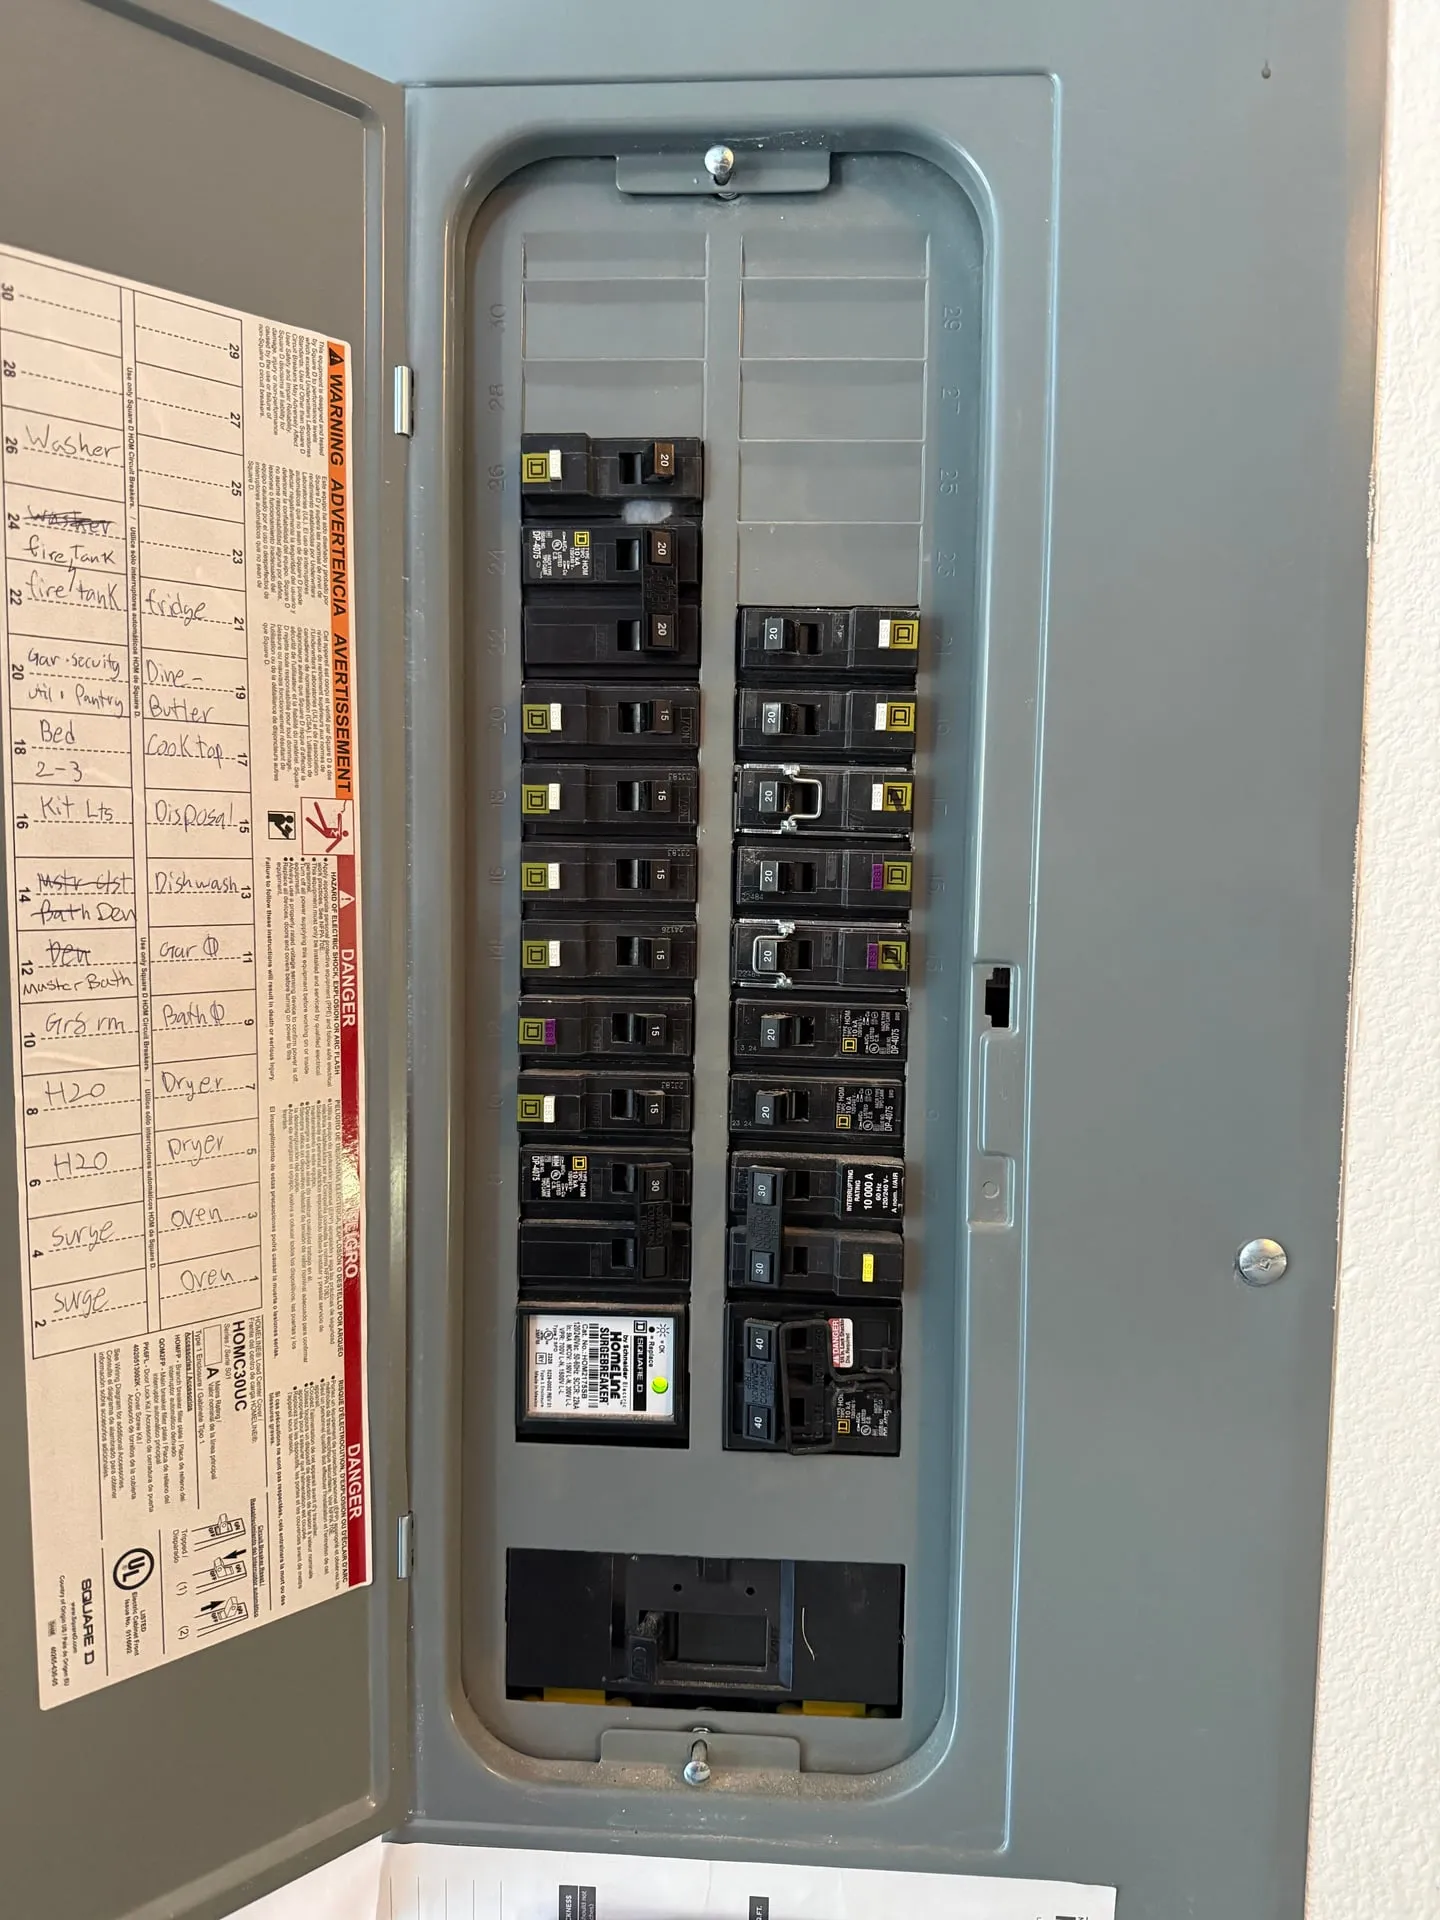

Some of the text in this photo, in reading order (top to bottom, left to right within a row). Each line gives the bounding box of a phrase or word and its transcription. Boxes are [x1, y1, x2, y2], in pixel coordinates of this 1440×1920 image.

[1, 283, 14, 301] 30
[229, 343, 240, 359] 29
[3, 360, 16, 378] 28
[230, 412, 241, 429] 27
[330, 374, 344, 466] WARNING
[6, 436, 18, 454] 26
[26, 424, 121, 458] Washer
[660, 454, 669, 468] 20
[231, 480, 242, 497] 25
[8, 514, 20, 530] 24
[23, 535, 67, 563] fire
[331, 479, 347, 617] ADVERTENCIA
[532, 530, 541, 560] DP-4075
[657, 541, 666, 556] 20
[232, 549, 243, 565] 23
[26, 570, 67, 599] fire
[10, 589, 22, 605] 22
[145, 588, 207, 627] fridge
[130, 567, 138, 611] interruptores
[134, 675, 140, 684] de
[234, 617, 245, 631] 21
[657, 622, 667, 636] 20
[770, 627, 778, 640] 20
[28, 648, 60, 667] Gar
[12, 664, 24, 680] 20
[146, 659, 189, 687] Dine
[76, 683, 124, 718] Pantry
[235, 685, 246, 699] 19
[334, 632, 352, 793] AVERTISSEMENT
[661, 710, 669, 720] 15
[768, 711, 776, 724] 20
[40, 719, 75, 744] Bed
[14, 739, 26, 755] 18
[238, 753, 248, 767] 17
[36, 761, 82, 782] 2-3
[658, 790, 666, 801] 15
[764, 790, 773, 802] 20
[40, 795, 113, 821] Kit Lts
[155, 799, 233, 832] Disposal
[16, 813, 29, 830] 16
[239, 819, 250, 834] 15
[155, 871, 239, 895] Dishwash
[656, 869, 664, 880] 15
[764, 870, 773, 882] 20
[18, 887, 31, 903] 14
[241, 885, 251, 899] 13
[97, 902, 137, 921] Den
[46, 939, 91, 966] Den
[160, 941, 197, 959] Gar
[243, 951, 253, 964] 11
[656, 950, 664, 960] 15
[764, 950, 772, 962] 20
[21, 960, 34, 976] 12
[22, 968, 134, 997] Master Bath
[340, 948, 356, 1029] DANGER
[163, 1001, 208, 1027] Bath
[97, 1016, 125, 1032] rm
[652, 1026, 660, 1036] 15
[24, 1032, 36, 1048] 10
[767, 1028, 775, 1040] 20
[891, 1028, 900, 1054] DP-4075
[45, 1081, 105, 1106] H2O
[161, 1071, 224, 1101] Dryer
[650, 1102, 658, 1114] 15
[762, 1106, 770, 1118] 20
[885, 1106, 893, 1132] DP-4075
[54, 1152, 107, 1180] H2O
[532, 1156, 540, 1181] DP-4075
[651, 1179, 660, 1192] 30
[758, 1184, 766, 1196] 30
[846, 1170, 854, 1212] INTERRUPTING
[864, 1182, 873, 1198] 000
[876, 1183, 882, 1200] 60 Hz
[864, 1200, 873, 1210] 10
[171, 1206, 222, 1227] Oven
[51, 1221, 114, 1252] Surge
[756, 1262, 764, 1274] 30
[180, 1267, 234, 1291] Oven
[53, 1287, 106, 1318] Surge
[622, 1335, 629, 1343] by
[756, 1338, 764, 1350] 40
[659, 1345, 665, 1354] OK
[206, 1367, 219, 1379] A
[232, 1320, 248, 1412] HOMC30UC
[600, 1328, 609, 1403] SURGEBREAKER
[636, 1338, 644, 1392] SQUARE D
[754, 1416, 762, 1428] 40
[346, 1442, 364, 1521] DANGER
[123, 1556, 145, 1582] UL
[176, 1581, 188, 1596] (1)
[82, 1579, 94, 1665] SQUARE D
[178, 1625, 189, 1640] (2)
